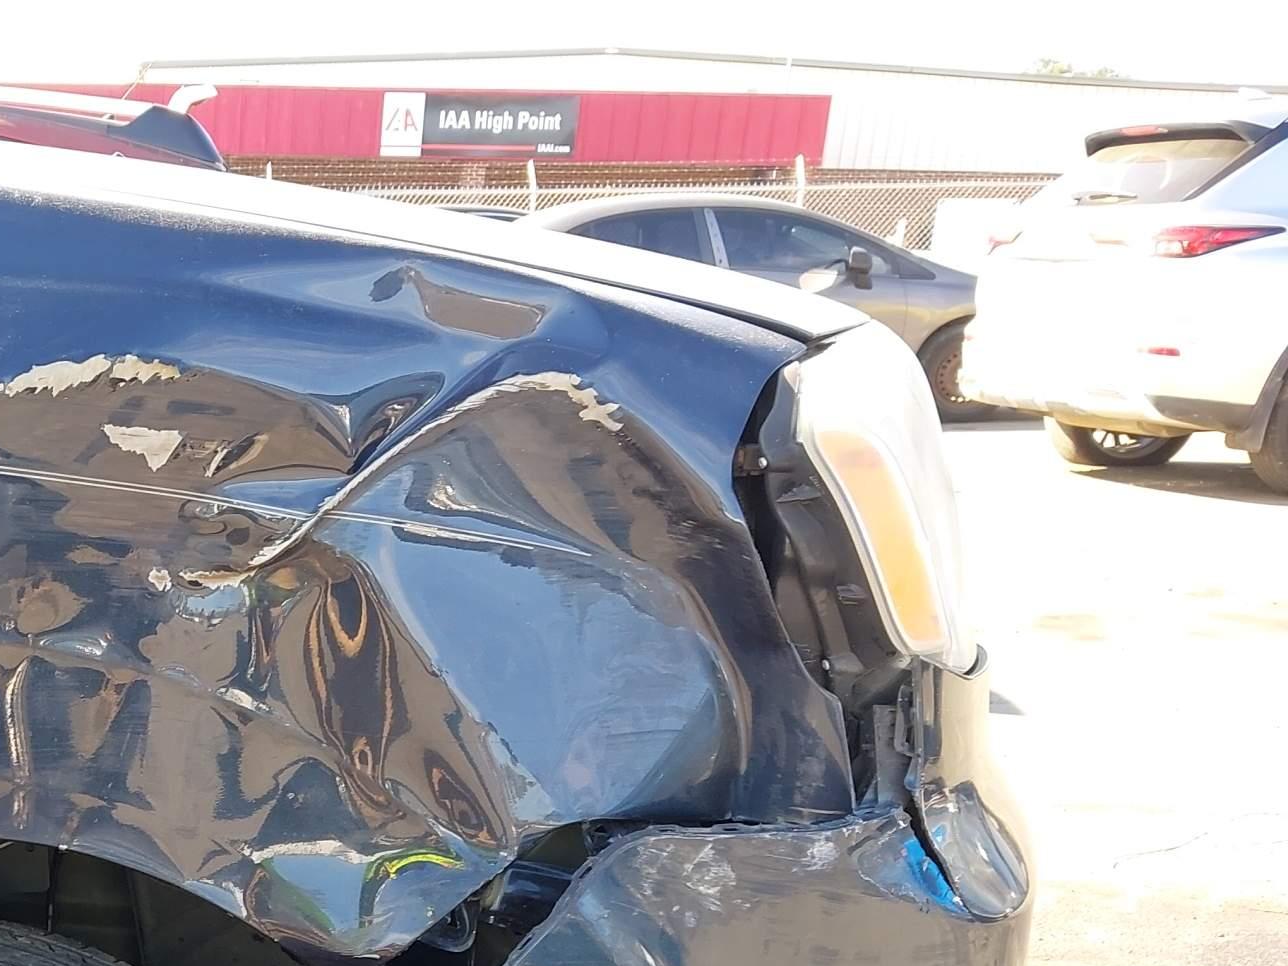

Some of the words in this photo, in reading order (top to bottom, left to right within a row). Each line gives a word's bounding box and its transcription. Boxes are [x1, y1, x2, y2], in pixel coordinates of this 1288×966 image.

[439, 110, 471, 130] IAA
[474, 110, 513, 134] High
[517, 111, 562, 131] Point
